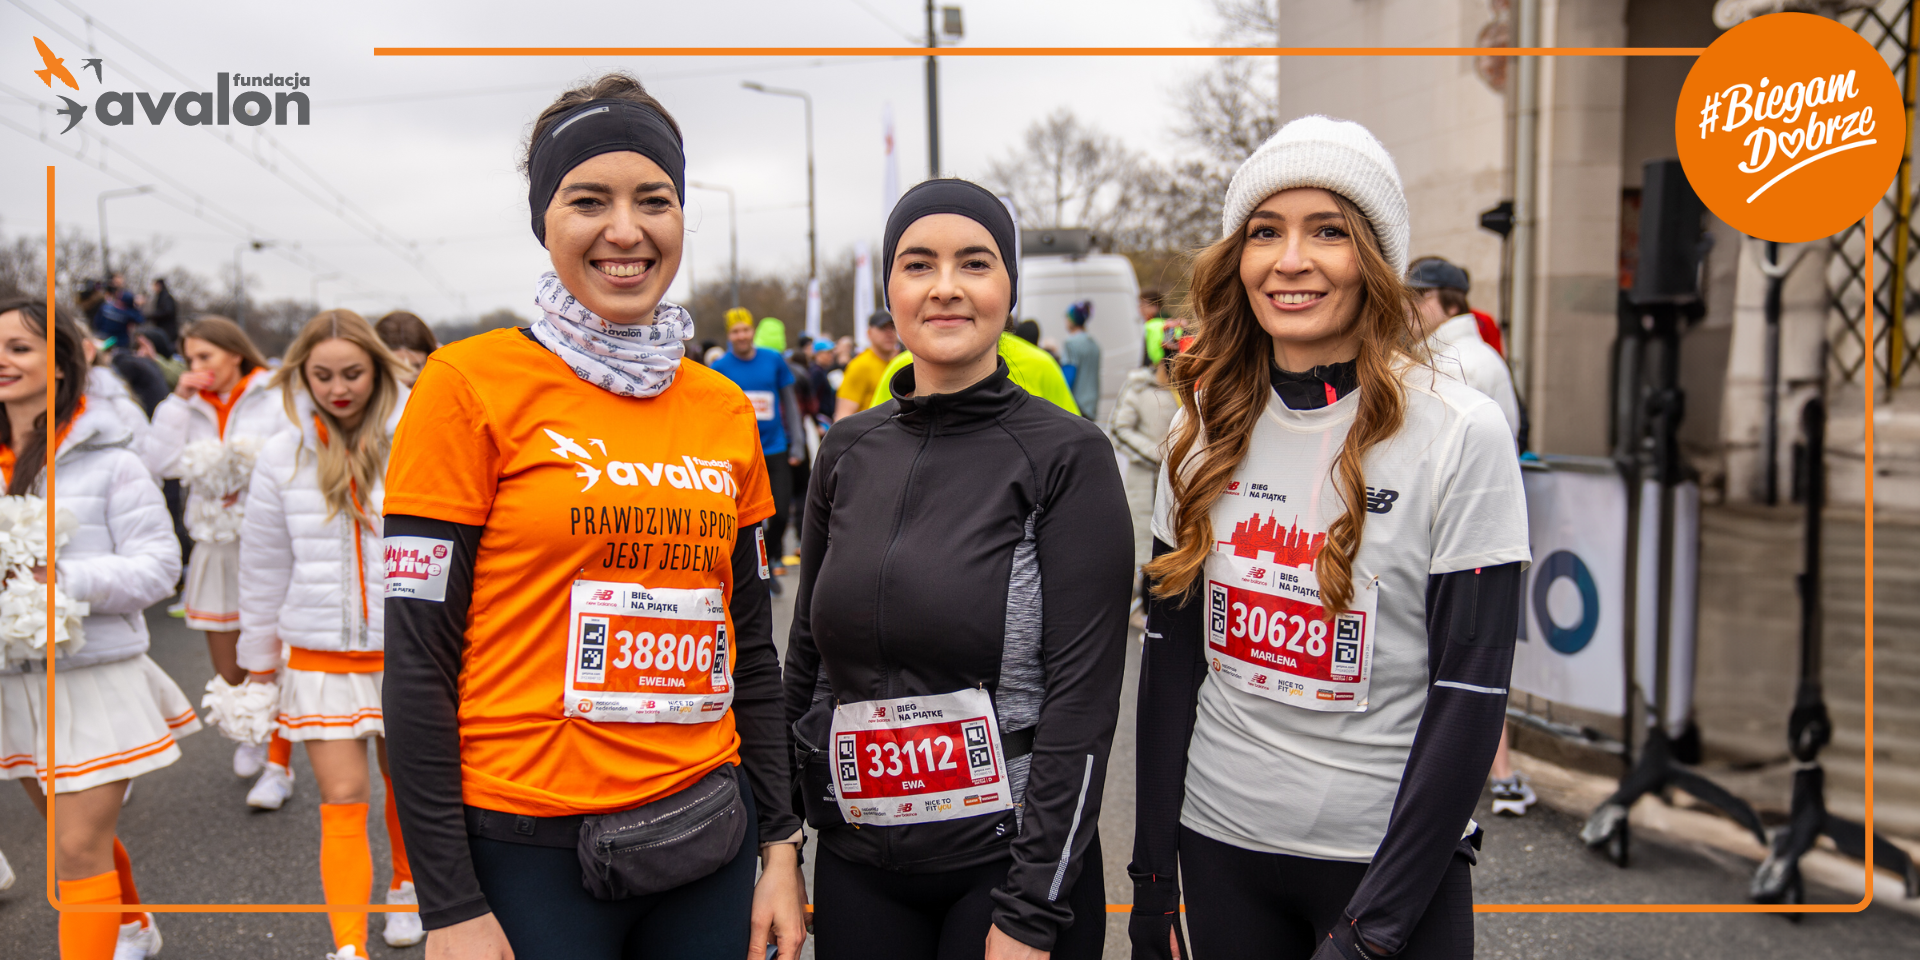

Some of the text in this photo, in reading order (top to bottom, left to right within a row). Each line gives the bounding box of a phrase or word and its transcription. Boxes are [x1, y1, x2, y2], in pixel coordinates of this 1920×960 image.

[608, 328, 642, 337] avalon
[606, 455, 738, 499] avalon
[1251, 483, 1268, 491] BIEG
[1249, 491, 1287, 503] NA PIĄTKĘ
[571, 506, 736, 543] PRAWDZIWY SPORT
[603, 542, 719, 572] JEST JEDEN!
[399, 556, 442, 577] five
[1250, 578, 1268, 586] balance
[1280, 572, 1299, 583] BIEG
[1279, 582, 1291, 591] NA
[631, 591, 653, 600] BIEG
[631, 601, 678, 614] NA PIĄTKĘ
[1231, 601, 1328, 657] 30628
[612, 630, 713, 672] 38806
[1250, 648, 1297, 668] MARLENA
[638, 676, 686, 687] EWELINA
[1278, 679, 1293, 688] NICE
[1289, 688, 1304, 696] you
[679, 706, 692, 714] you
[897, 703, 917, 712] BIEG
[899, 710, 943, 721] NA PIĄTKĘ
[865, 735, 957, 778] 33112
[901, 780, 925, 790] EWA
[937, 804, 952, 813] you
